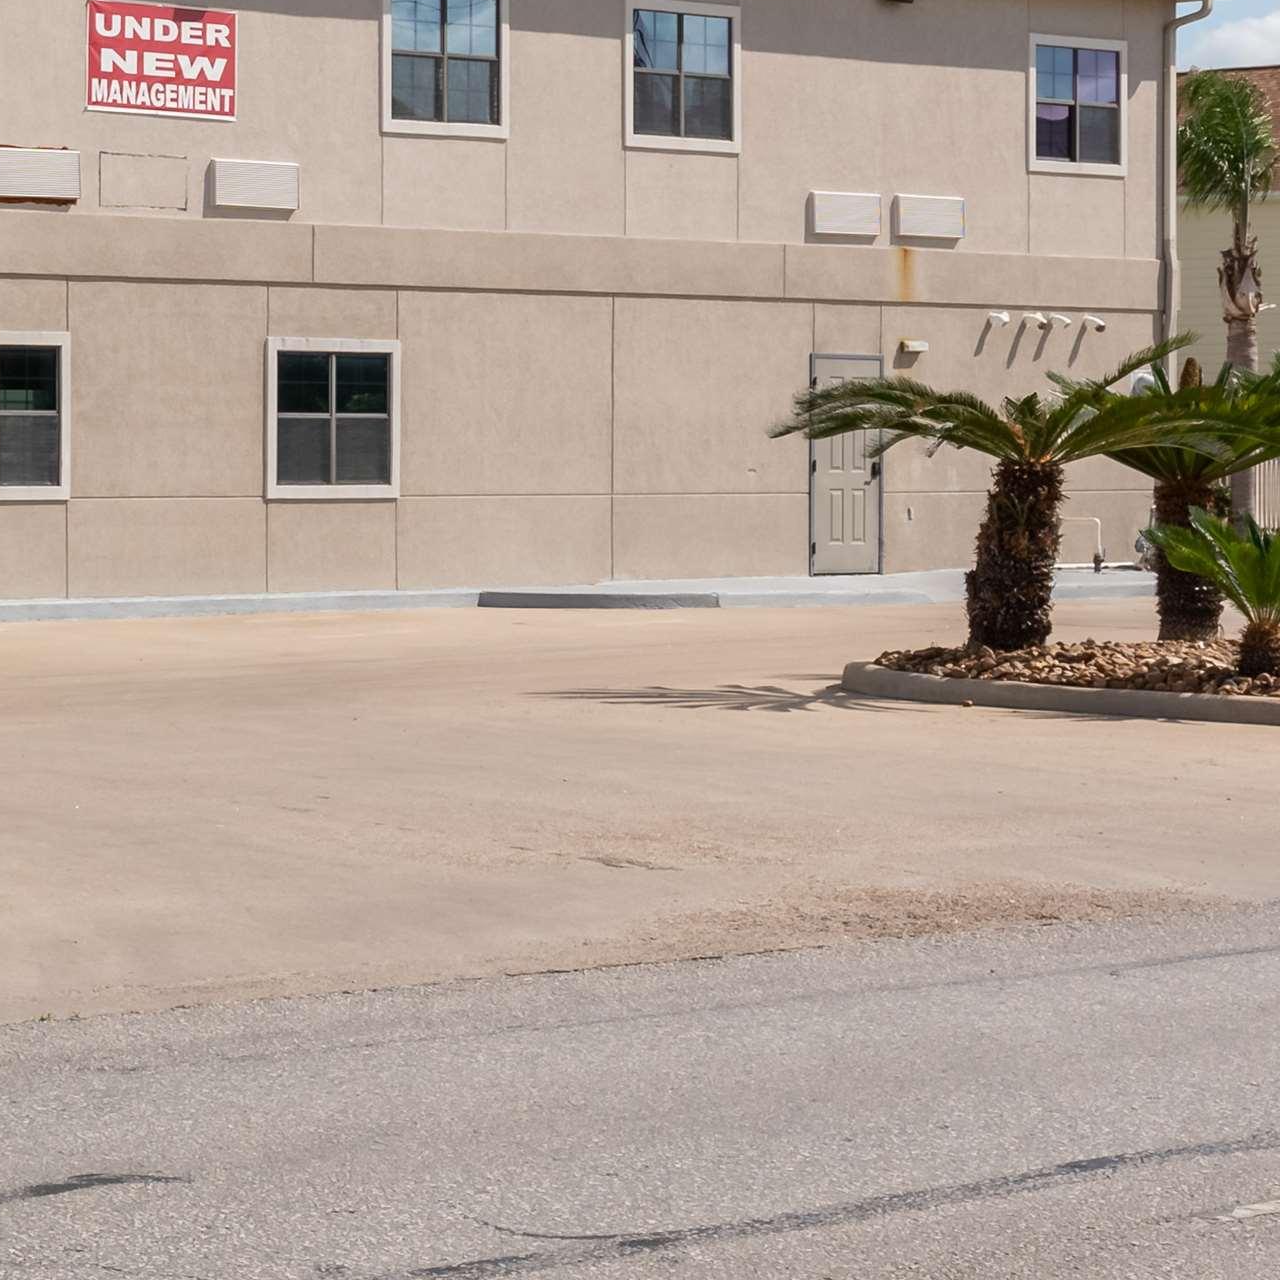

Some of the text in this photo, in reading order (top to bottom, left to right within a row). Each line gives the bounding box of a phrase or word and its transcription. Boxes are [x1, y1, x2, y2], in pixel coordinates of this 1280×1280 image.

[95, 13, 232, 48] UNDER
[100, 47, 228, 82] NEW
[91, 77, 235, 113] MANAGEMENT
